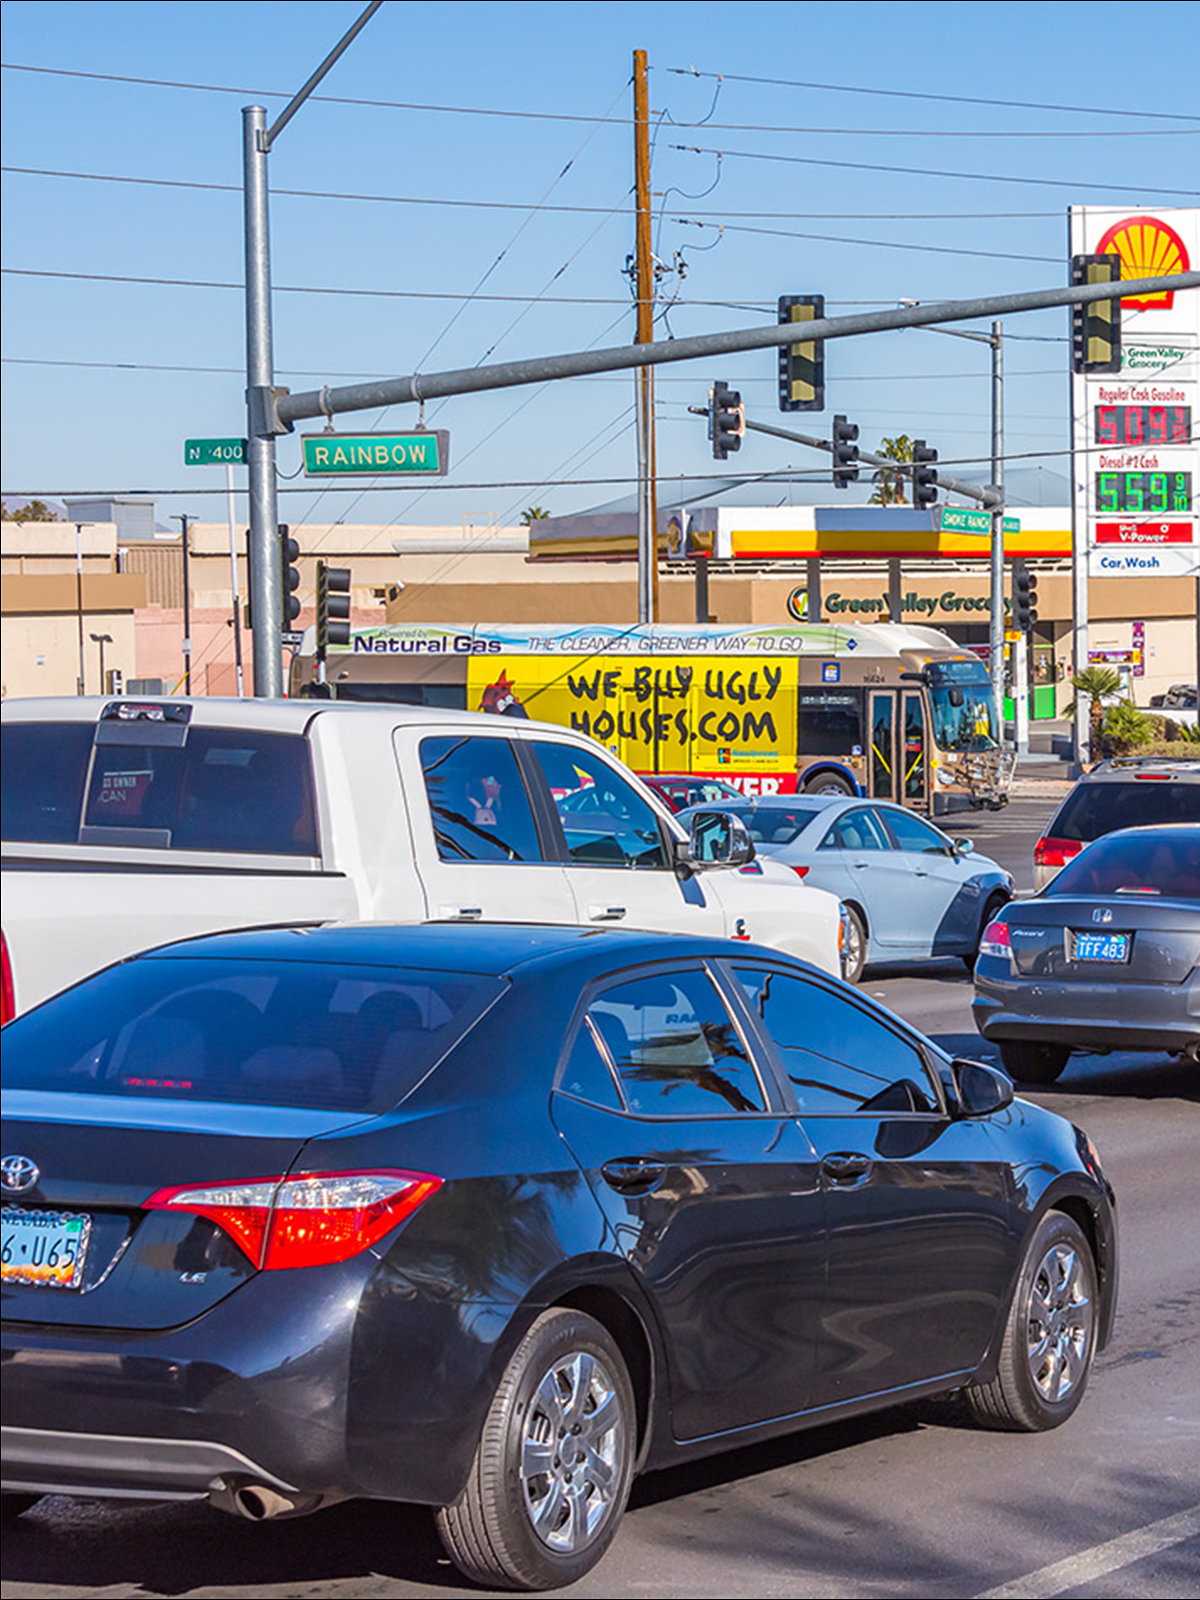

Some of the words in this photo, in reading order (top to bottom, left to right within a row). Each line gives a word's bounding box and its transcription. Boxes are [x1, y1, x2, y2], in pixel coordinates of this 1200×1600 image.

[1128, 348, 1157, 358] Green
[1157, 348, 1185, 360] Valley
[1128, 358, 1167, 369] Grocery
[1099, 387, 1129, 403] Regular
[1131, 388, 1150, 400] Cash
[1151, 388, 1186, 401] Gasoline
[315, 445, 426, 466] RAINBOW
[1099, 456, 1125, 469] Diesel
[1140, 456, 1159, 469] Cash
[1101, 557, 1122, 569] Car
[1125, 556, 1160, 568] Wash
[826, 593, 883, 613] Green
[883, 592, 938, 617] lley
[939, 592, 1012, 615] Grocey
[353, 636, 447, 653] Natural
[453, 636, 502, 653] Gas
[528, 636, 557, 651] THE
[638, 636, 709, 651] GREENER
[715, 636, 750, 651] WAY
[755, 636, 775, 651] TO
[567, 669, 622, 700] WE
[634, 665, 693, 703] BUY
[705, 665, 782, 706] UGLY
[570, 707, 778, 746] HOUSES.COM
